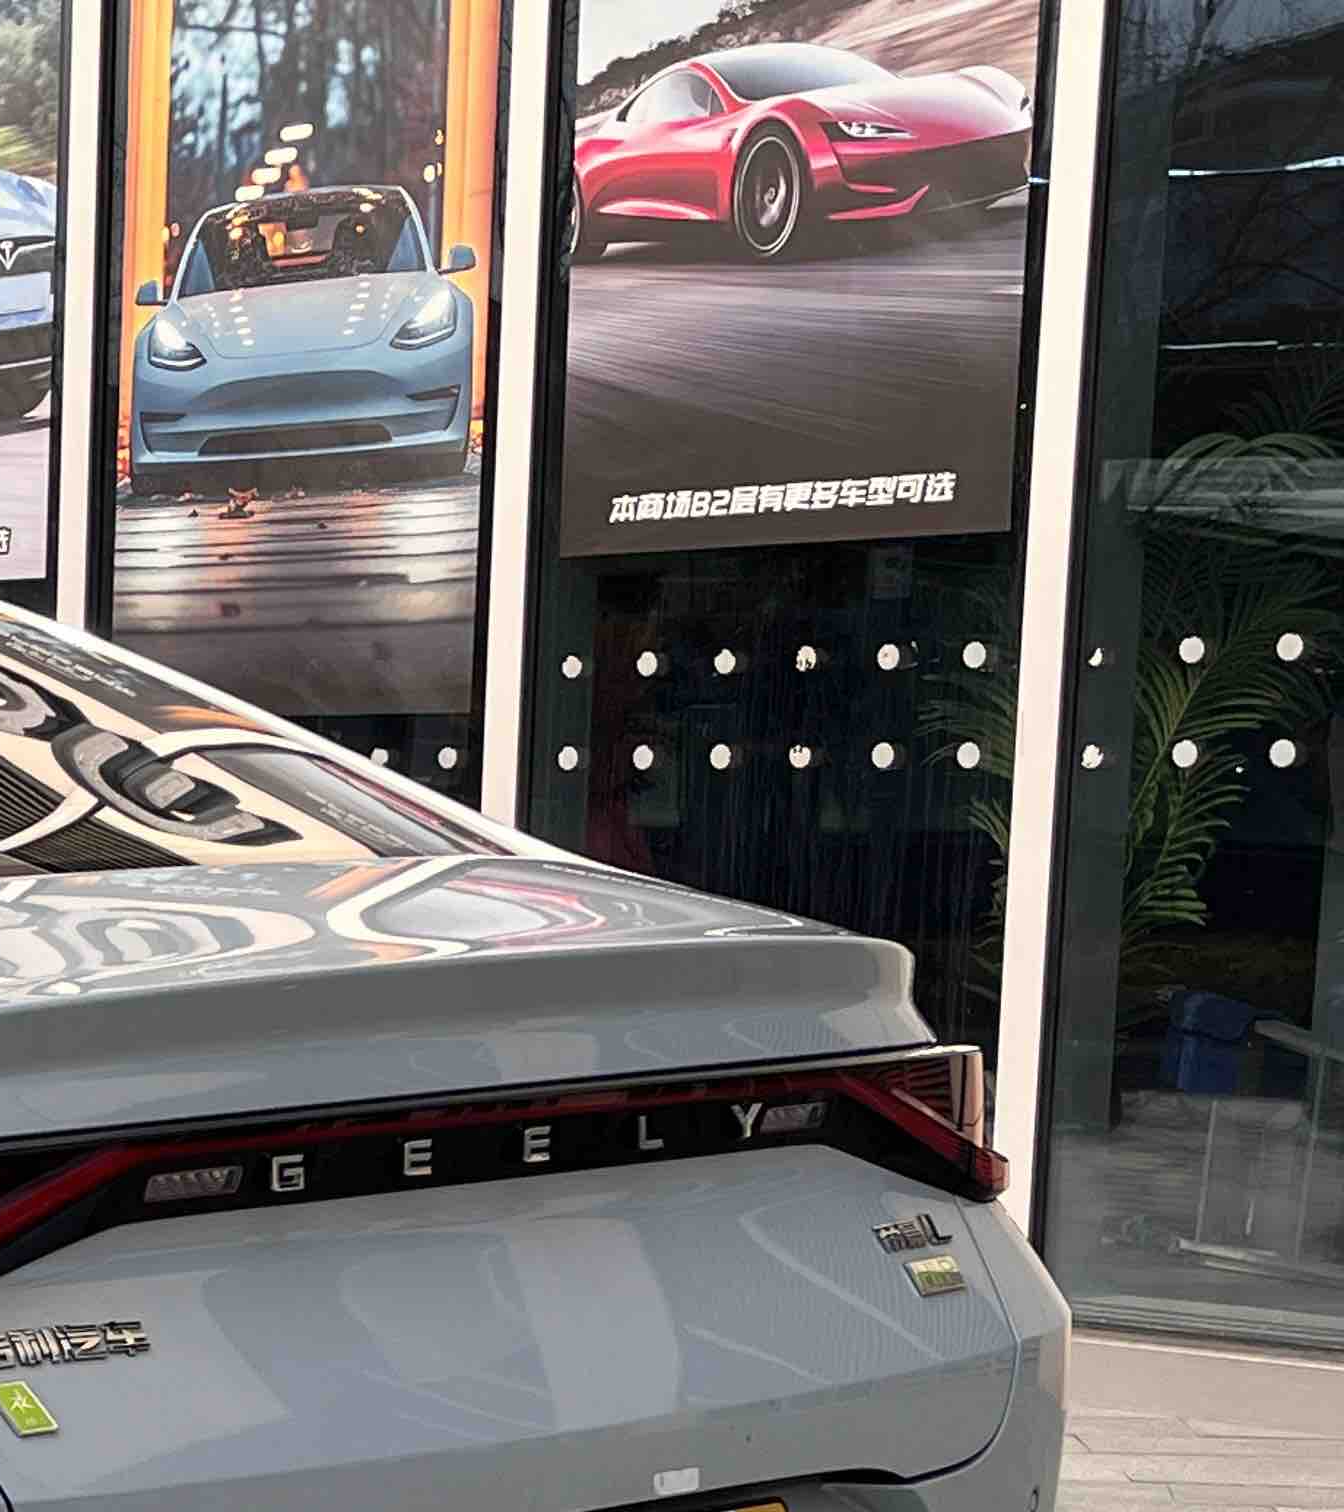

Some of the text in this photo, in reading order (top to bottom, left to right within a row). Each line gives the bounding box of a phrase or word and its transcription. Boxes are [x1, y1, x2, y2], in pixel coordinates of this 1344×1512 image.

[608, 471, 957, 524] 本商场B2层有更多车型可选
[269, 1102, 763, 1193] GEELY
